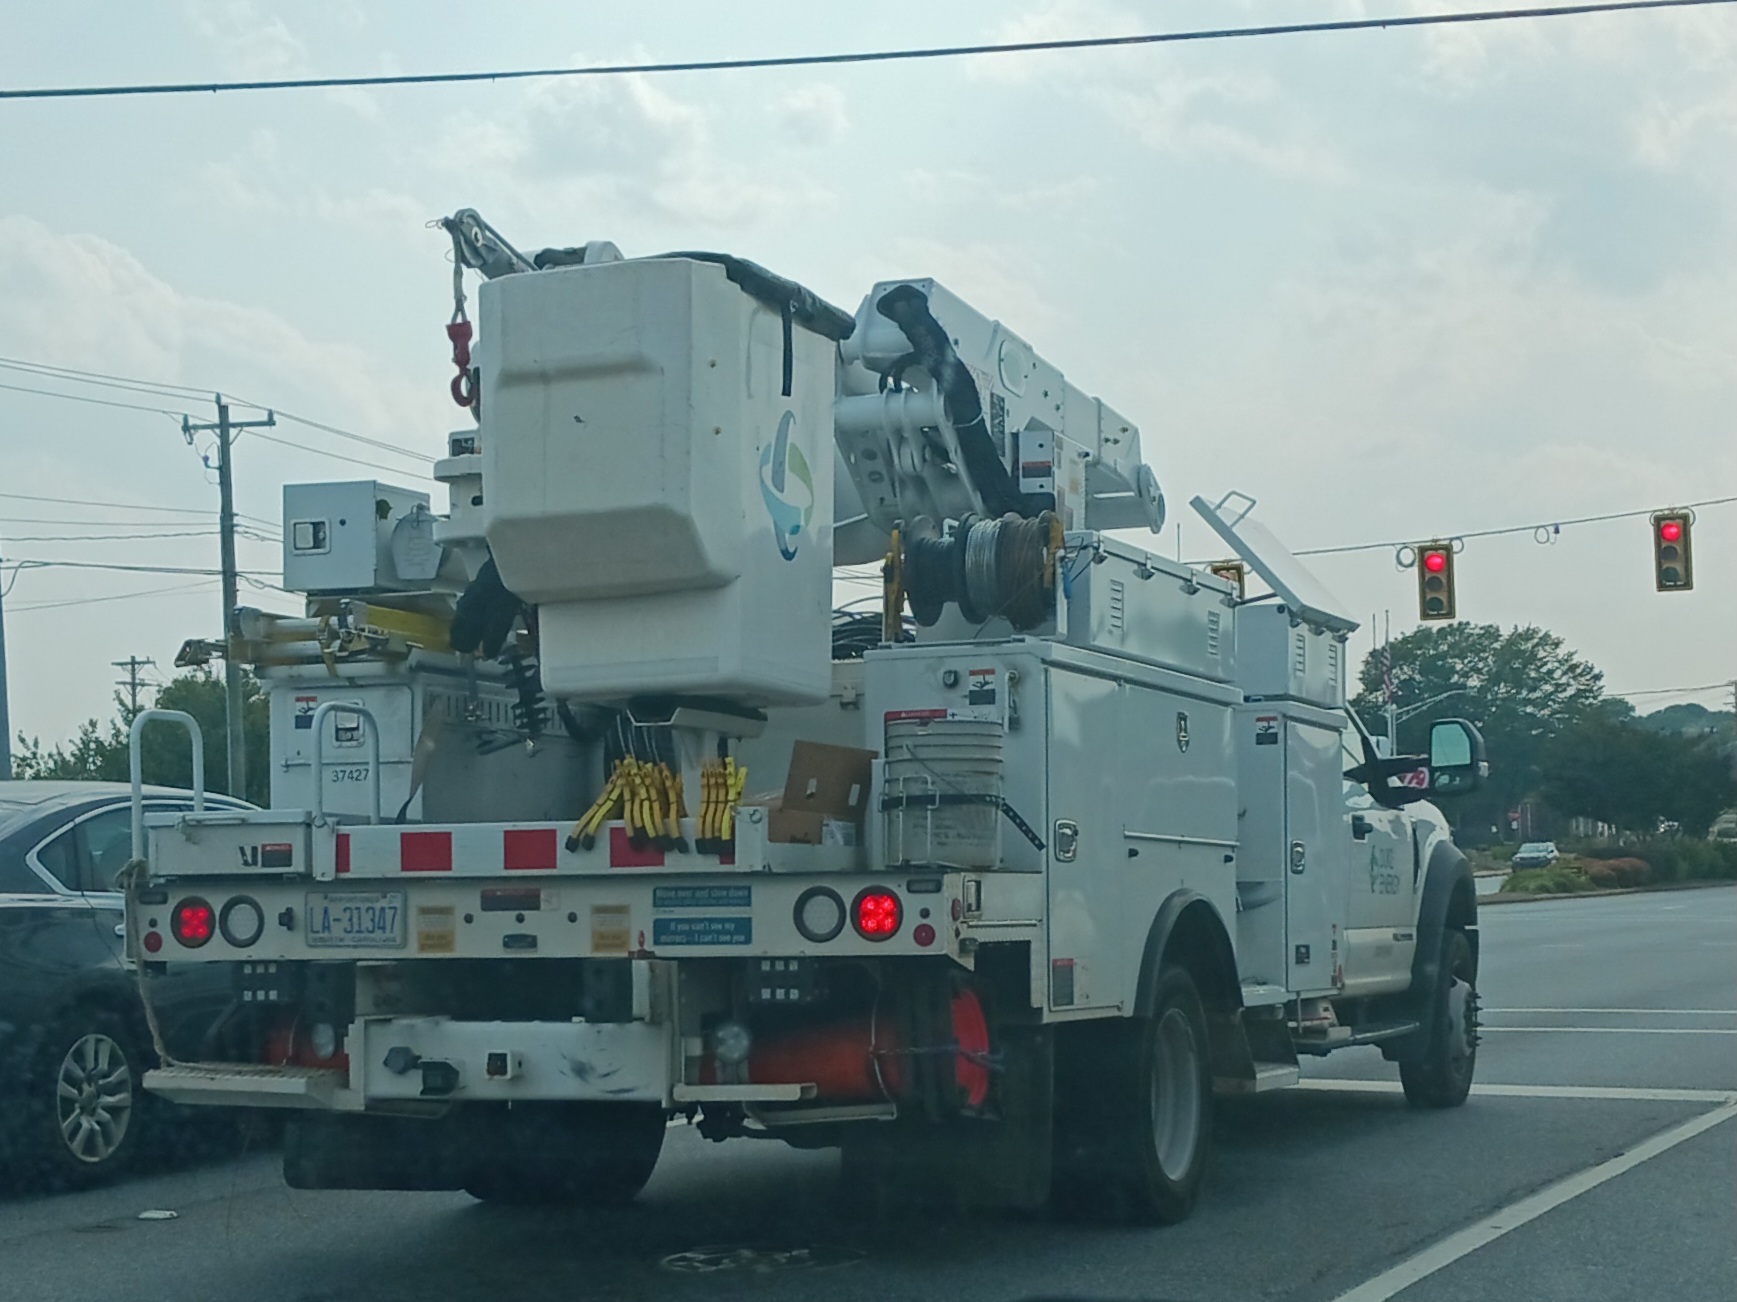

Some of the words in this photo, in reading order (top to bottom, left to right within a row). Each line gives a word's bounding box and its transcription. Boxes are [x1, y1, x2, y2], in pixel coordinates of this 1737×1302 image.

[332, 768, 369, 782] 37427
[677, 889, 693, 898] over
[694, 888, 709, 897] and
[711, 888, 727, 897] slow
[729, 888, 748, 897] down
[309, 905, 398, 934] LA-31347
[677, 923, 689, 932] you
[691, 922, 709, 930] can't
[724, 922, 735, 932] my
[700, 933, 717, 942] can't
[718, 934, 731, 942] see
[732, 934, 745, 943] you
